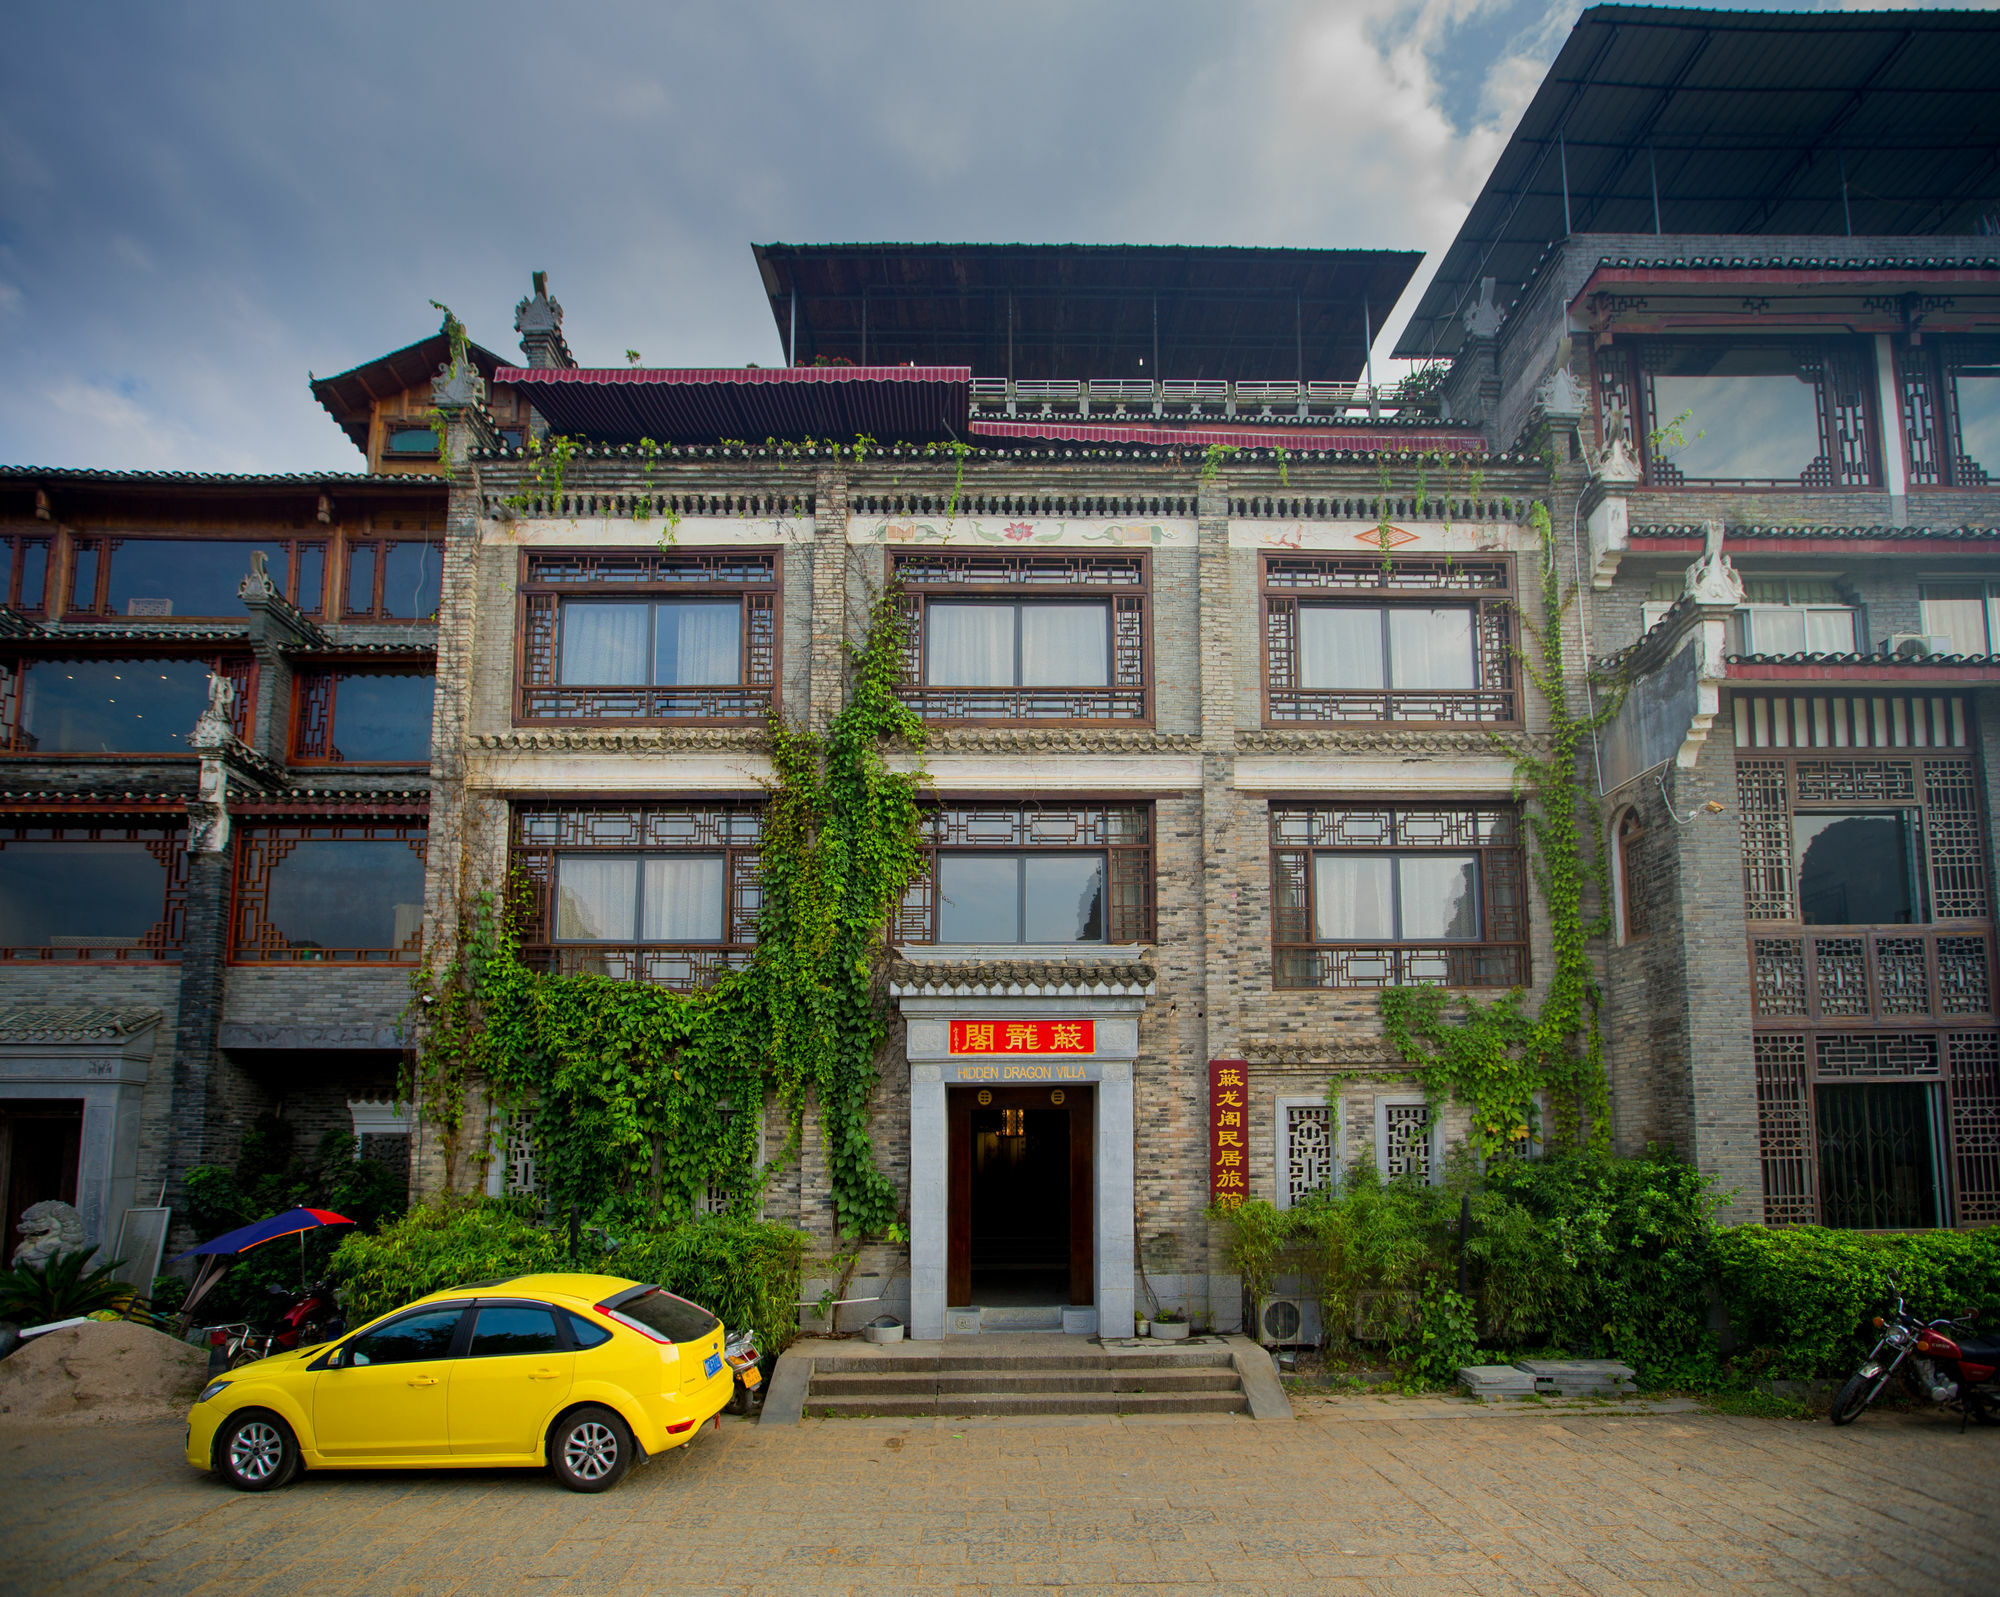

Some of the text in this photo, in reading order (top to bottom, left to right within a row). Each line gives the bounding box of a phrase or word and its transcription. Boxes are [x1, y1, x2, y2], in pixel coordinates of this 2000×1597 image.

[957, 1066, 1086, 1079] HIDDEN DRAGON VILLA
